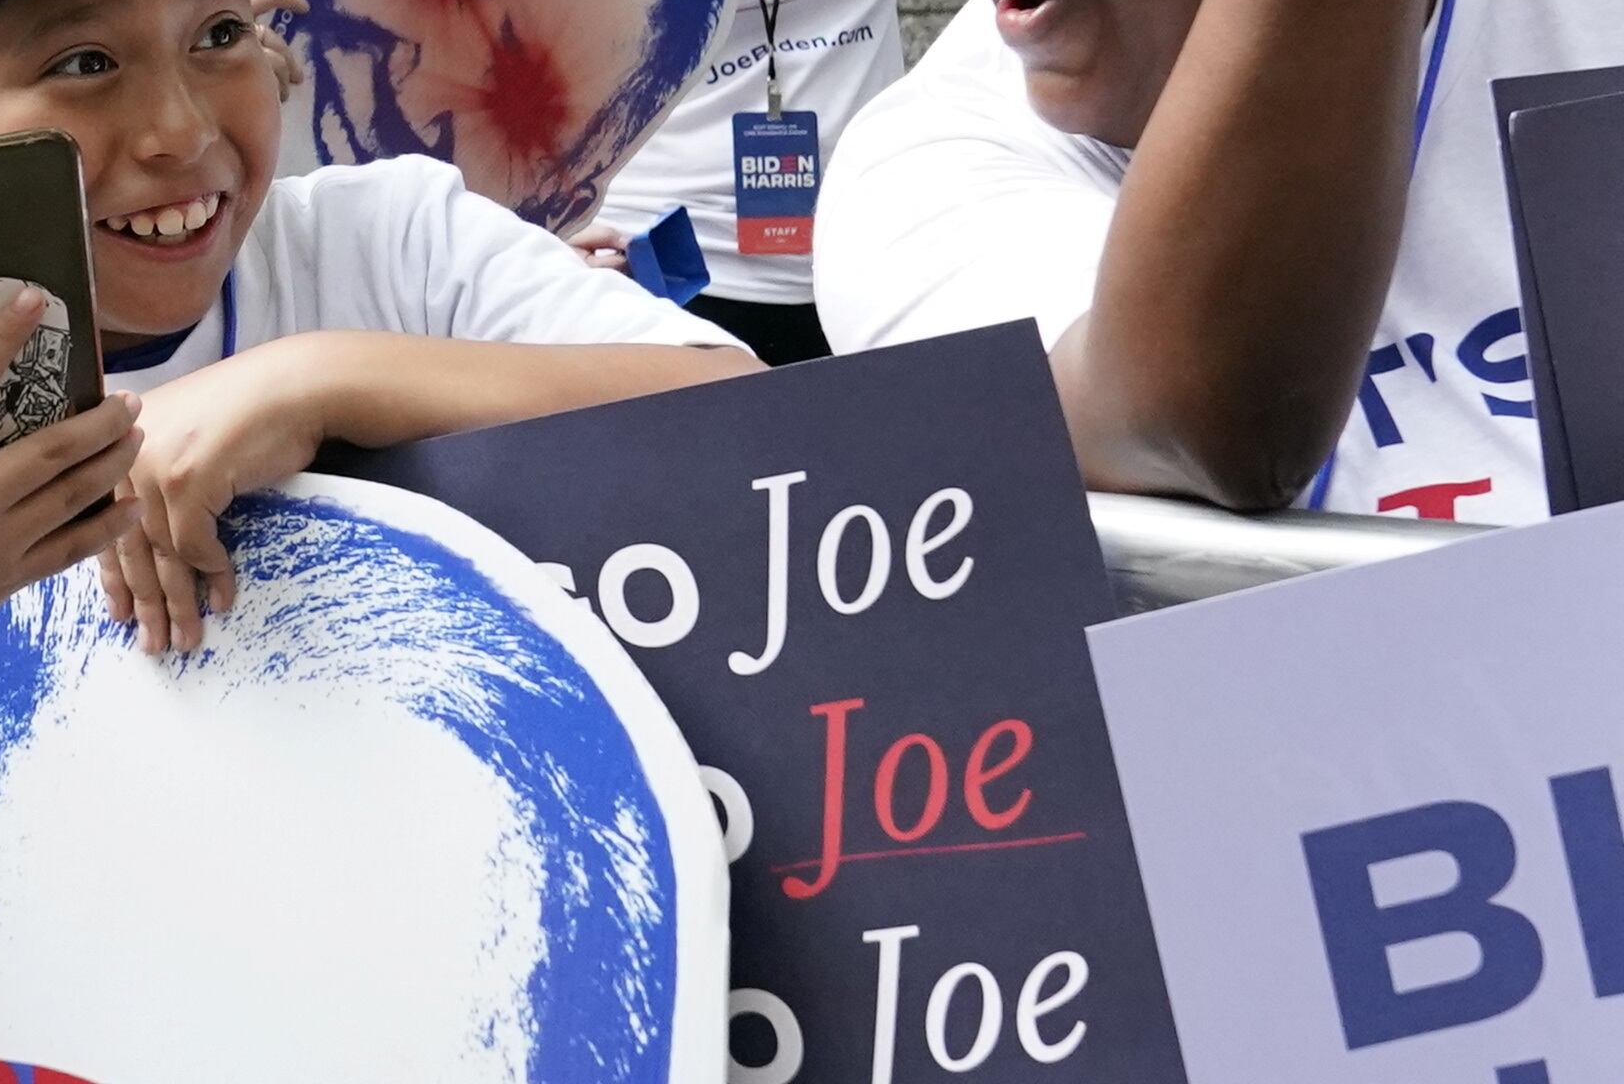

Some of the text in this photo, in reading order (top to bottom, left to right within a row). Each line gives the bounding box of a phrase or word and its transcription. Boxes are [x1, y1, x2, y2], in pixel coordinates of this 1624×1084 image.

[706, 23, 874, 85] JoeBden.com
[741, 155, 814, 173] BIDEN
[742, 174, 815, 189] HARRIS
[764, 227, 798, 236] STAFF
[728, 470, 975, 676] Joe
[781, 697, 1034, 900] Joe
[862, 926, 1090, 1084] Joe
